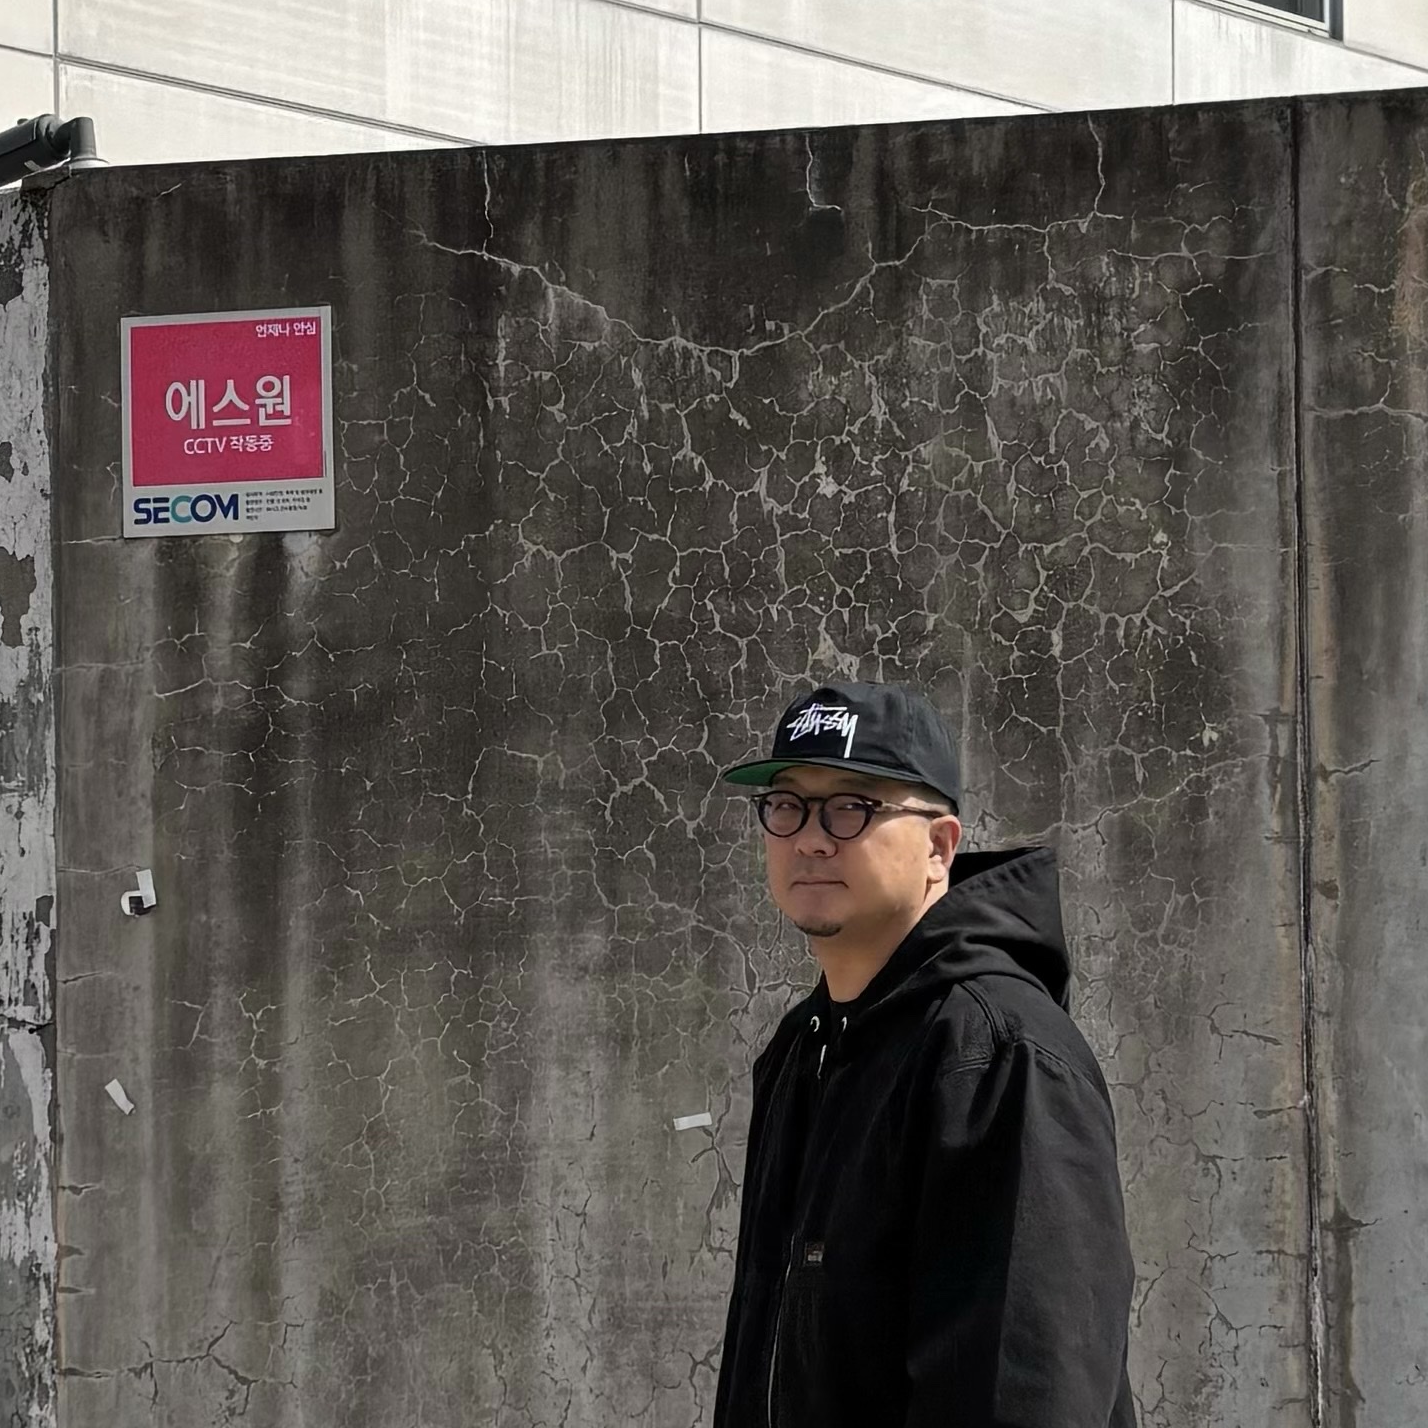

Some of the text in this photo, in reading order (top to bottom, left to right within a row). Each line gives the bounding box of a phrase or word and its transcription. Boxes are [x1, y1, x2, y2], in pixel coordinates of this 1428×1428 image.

[255, 321, 316, 338] 언제나 안심
[165, 375, 292, 430] 에스원
[184, 434, 275, 455] CCTV 작동중
[133, 494, 239, 525] SECOM
